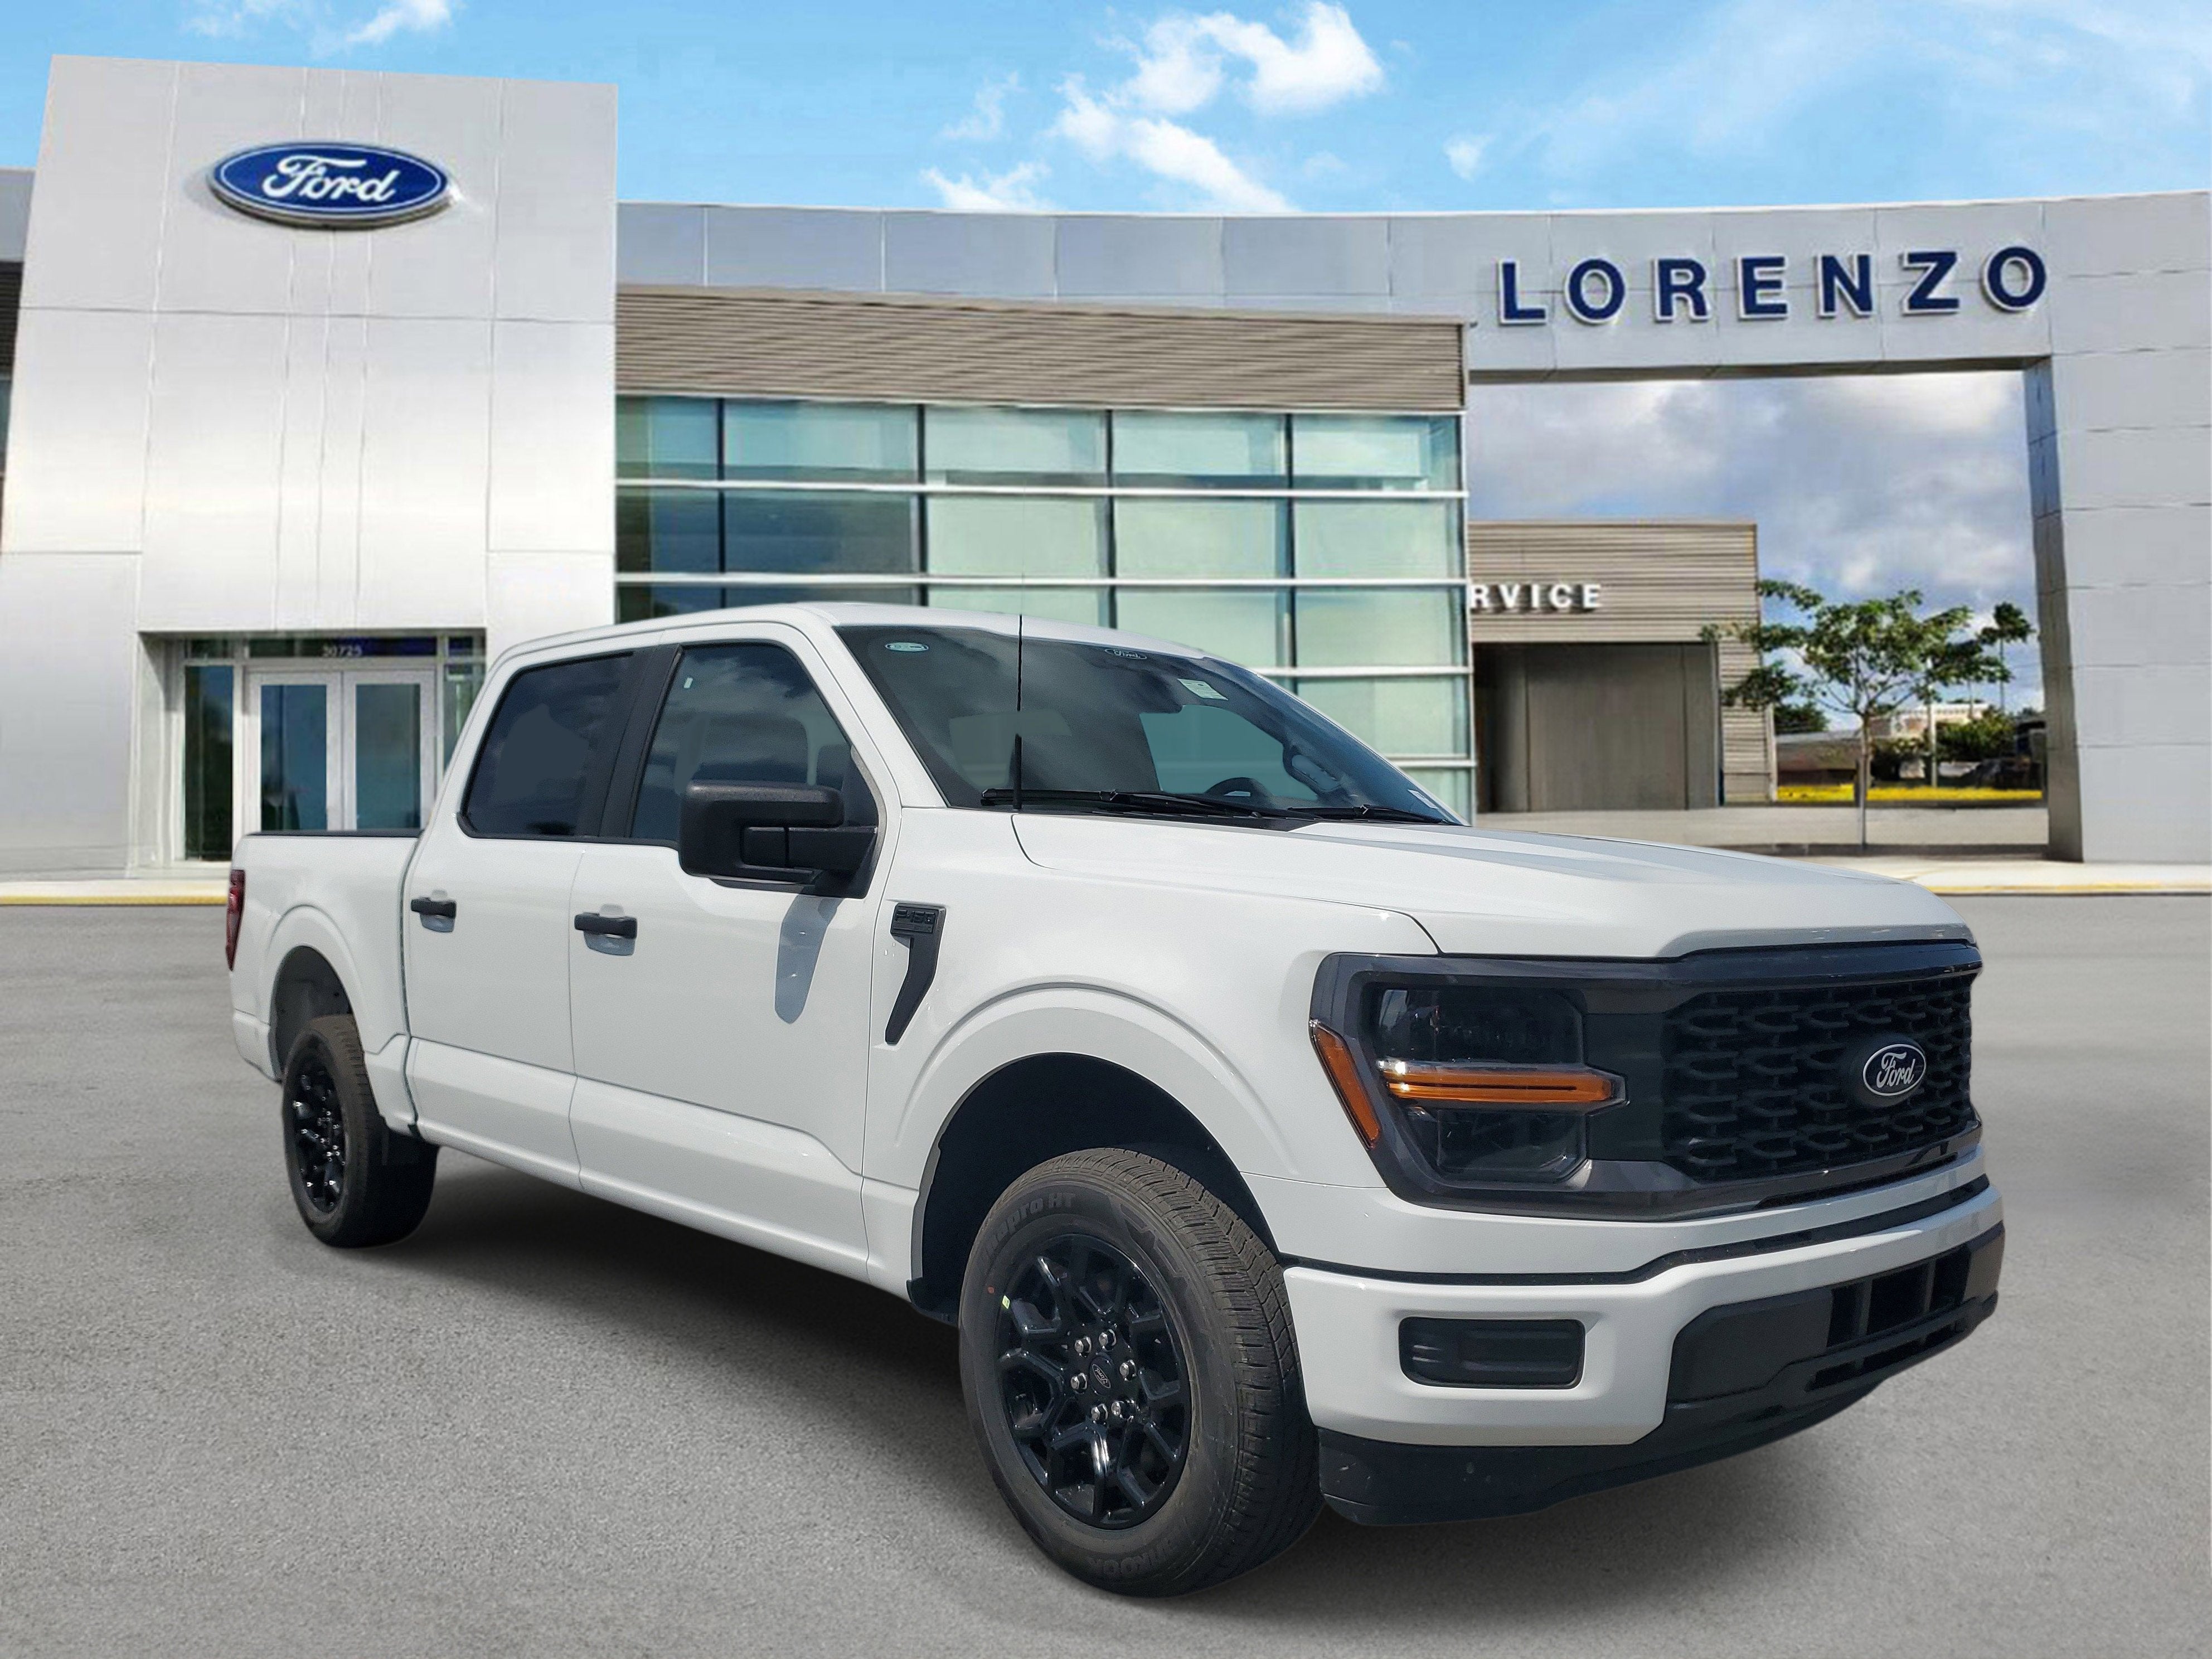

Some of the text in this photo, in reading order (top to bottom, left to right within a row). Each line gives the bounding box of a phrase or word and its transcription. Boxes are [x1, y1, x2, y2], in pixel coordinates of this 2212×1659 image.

[263, 154, 400, 202] Ford
[1499, 246, 2047, 324] LORENZO
[1876, 1052, 1915, 1088] Ford
